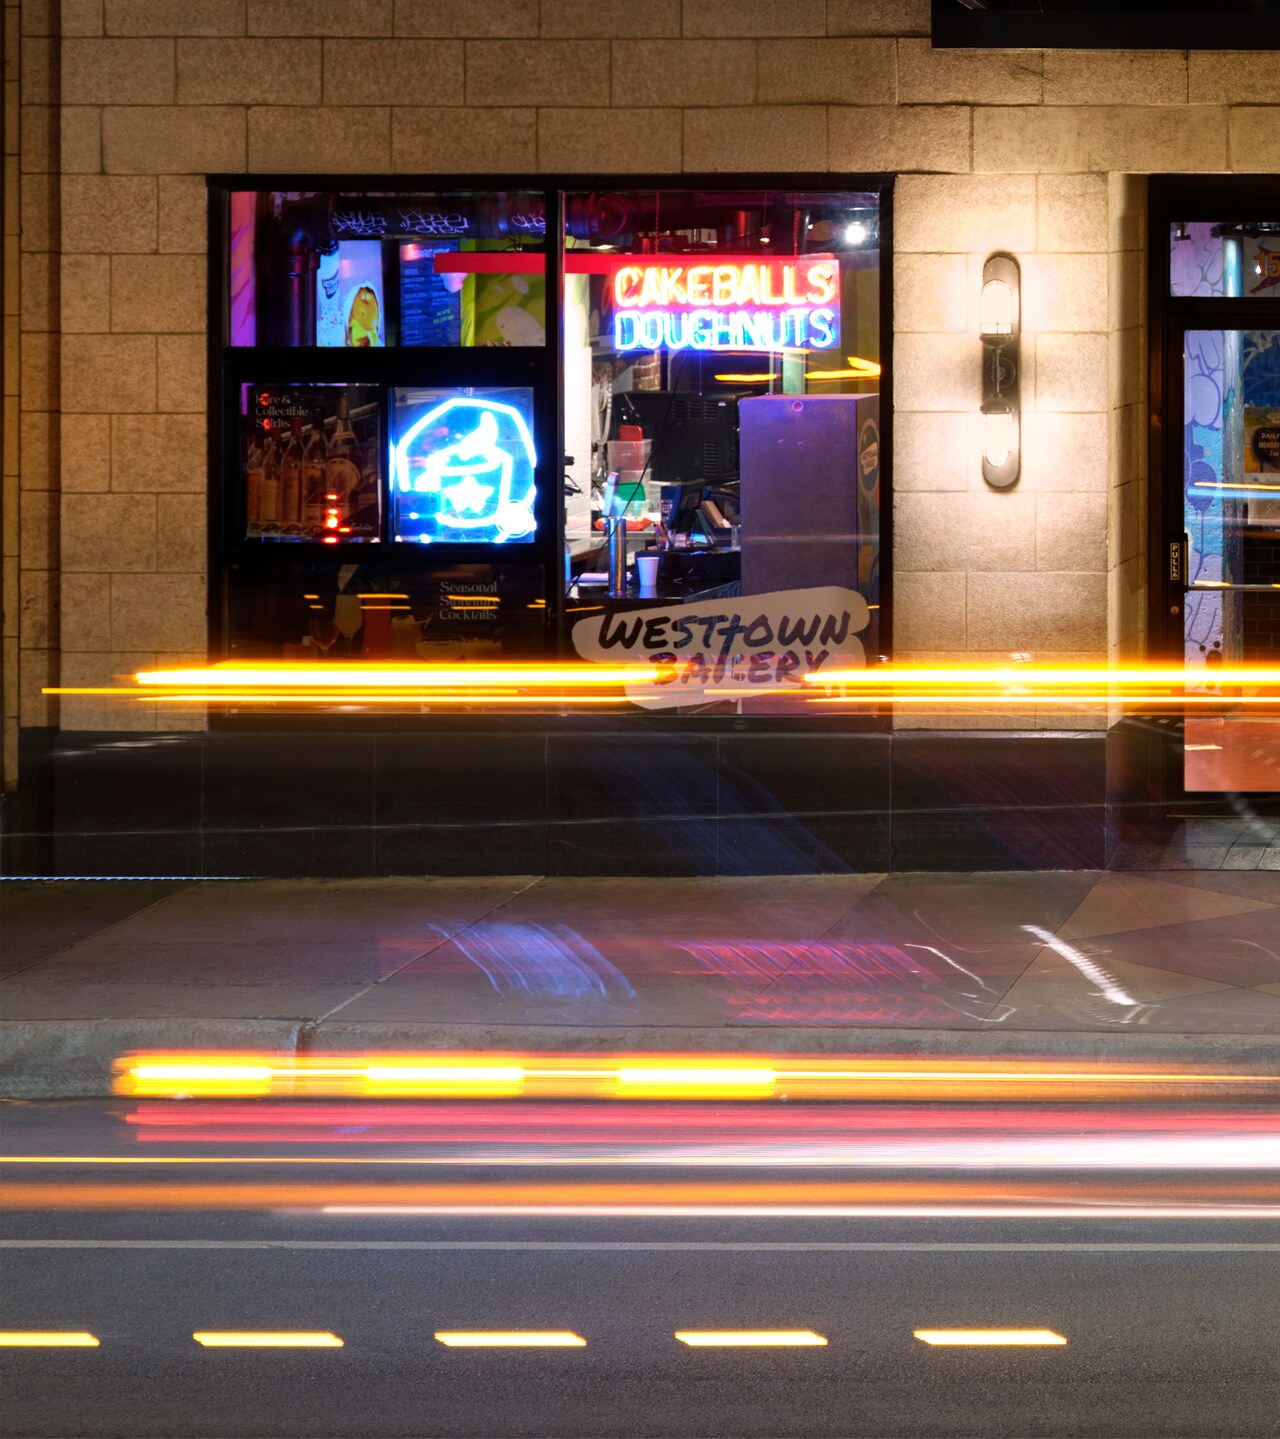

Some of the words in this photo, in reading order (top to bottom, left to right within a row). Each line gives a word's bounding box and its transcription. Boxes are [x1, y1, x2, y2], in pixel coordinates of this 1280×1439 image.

[614, 264, 835, 308] CAKEBALLS
[614, 308, 835, 351] DOUGHNUTS
[255, 417, 291, 430] Sirits
[439, 580, 498, 593] Seasonal
[438, 609, 498, 621] Cocktails
